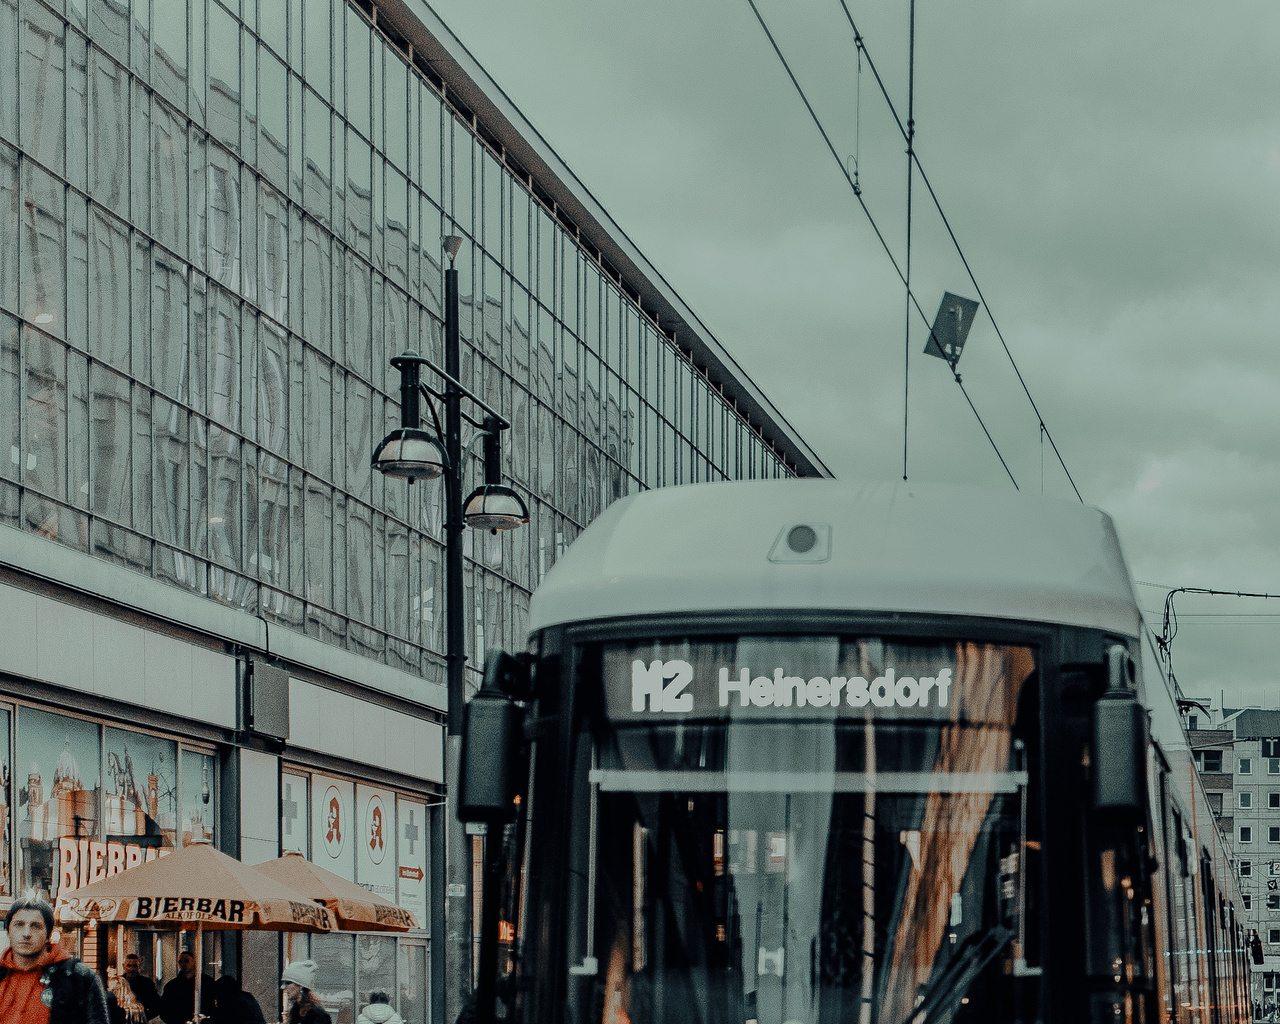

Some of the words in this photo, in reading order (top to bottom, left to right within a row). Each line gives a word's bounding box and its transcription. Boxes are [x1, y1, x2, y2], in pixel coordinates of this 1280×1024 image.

[631, 659, 694, 713] M2
[718, 667, 952, 708] Heinersdorf
[136, 896, 245, 922] BIERBAR
